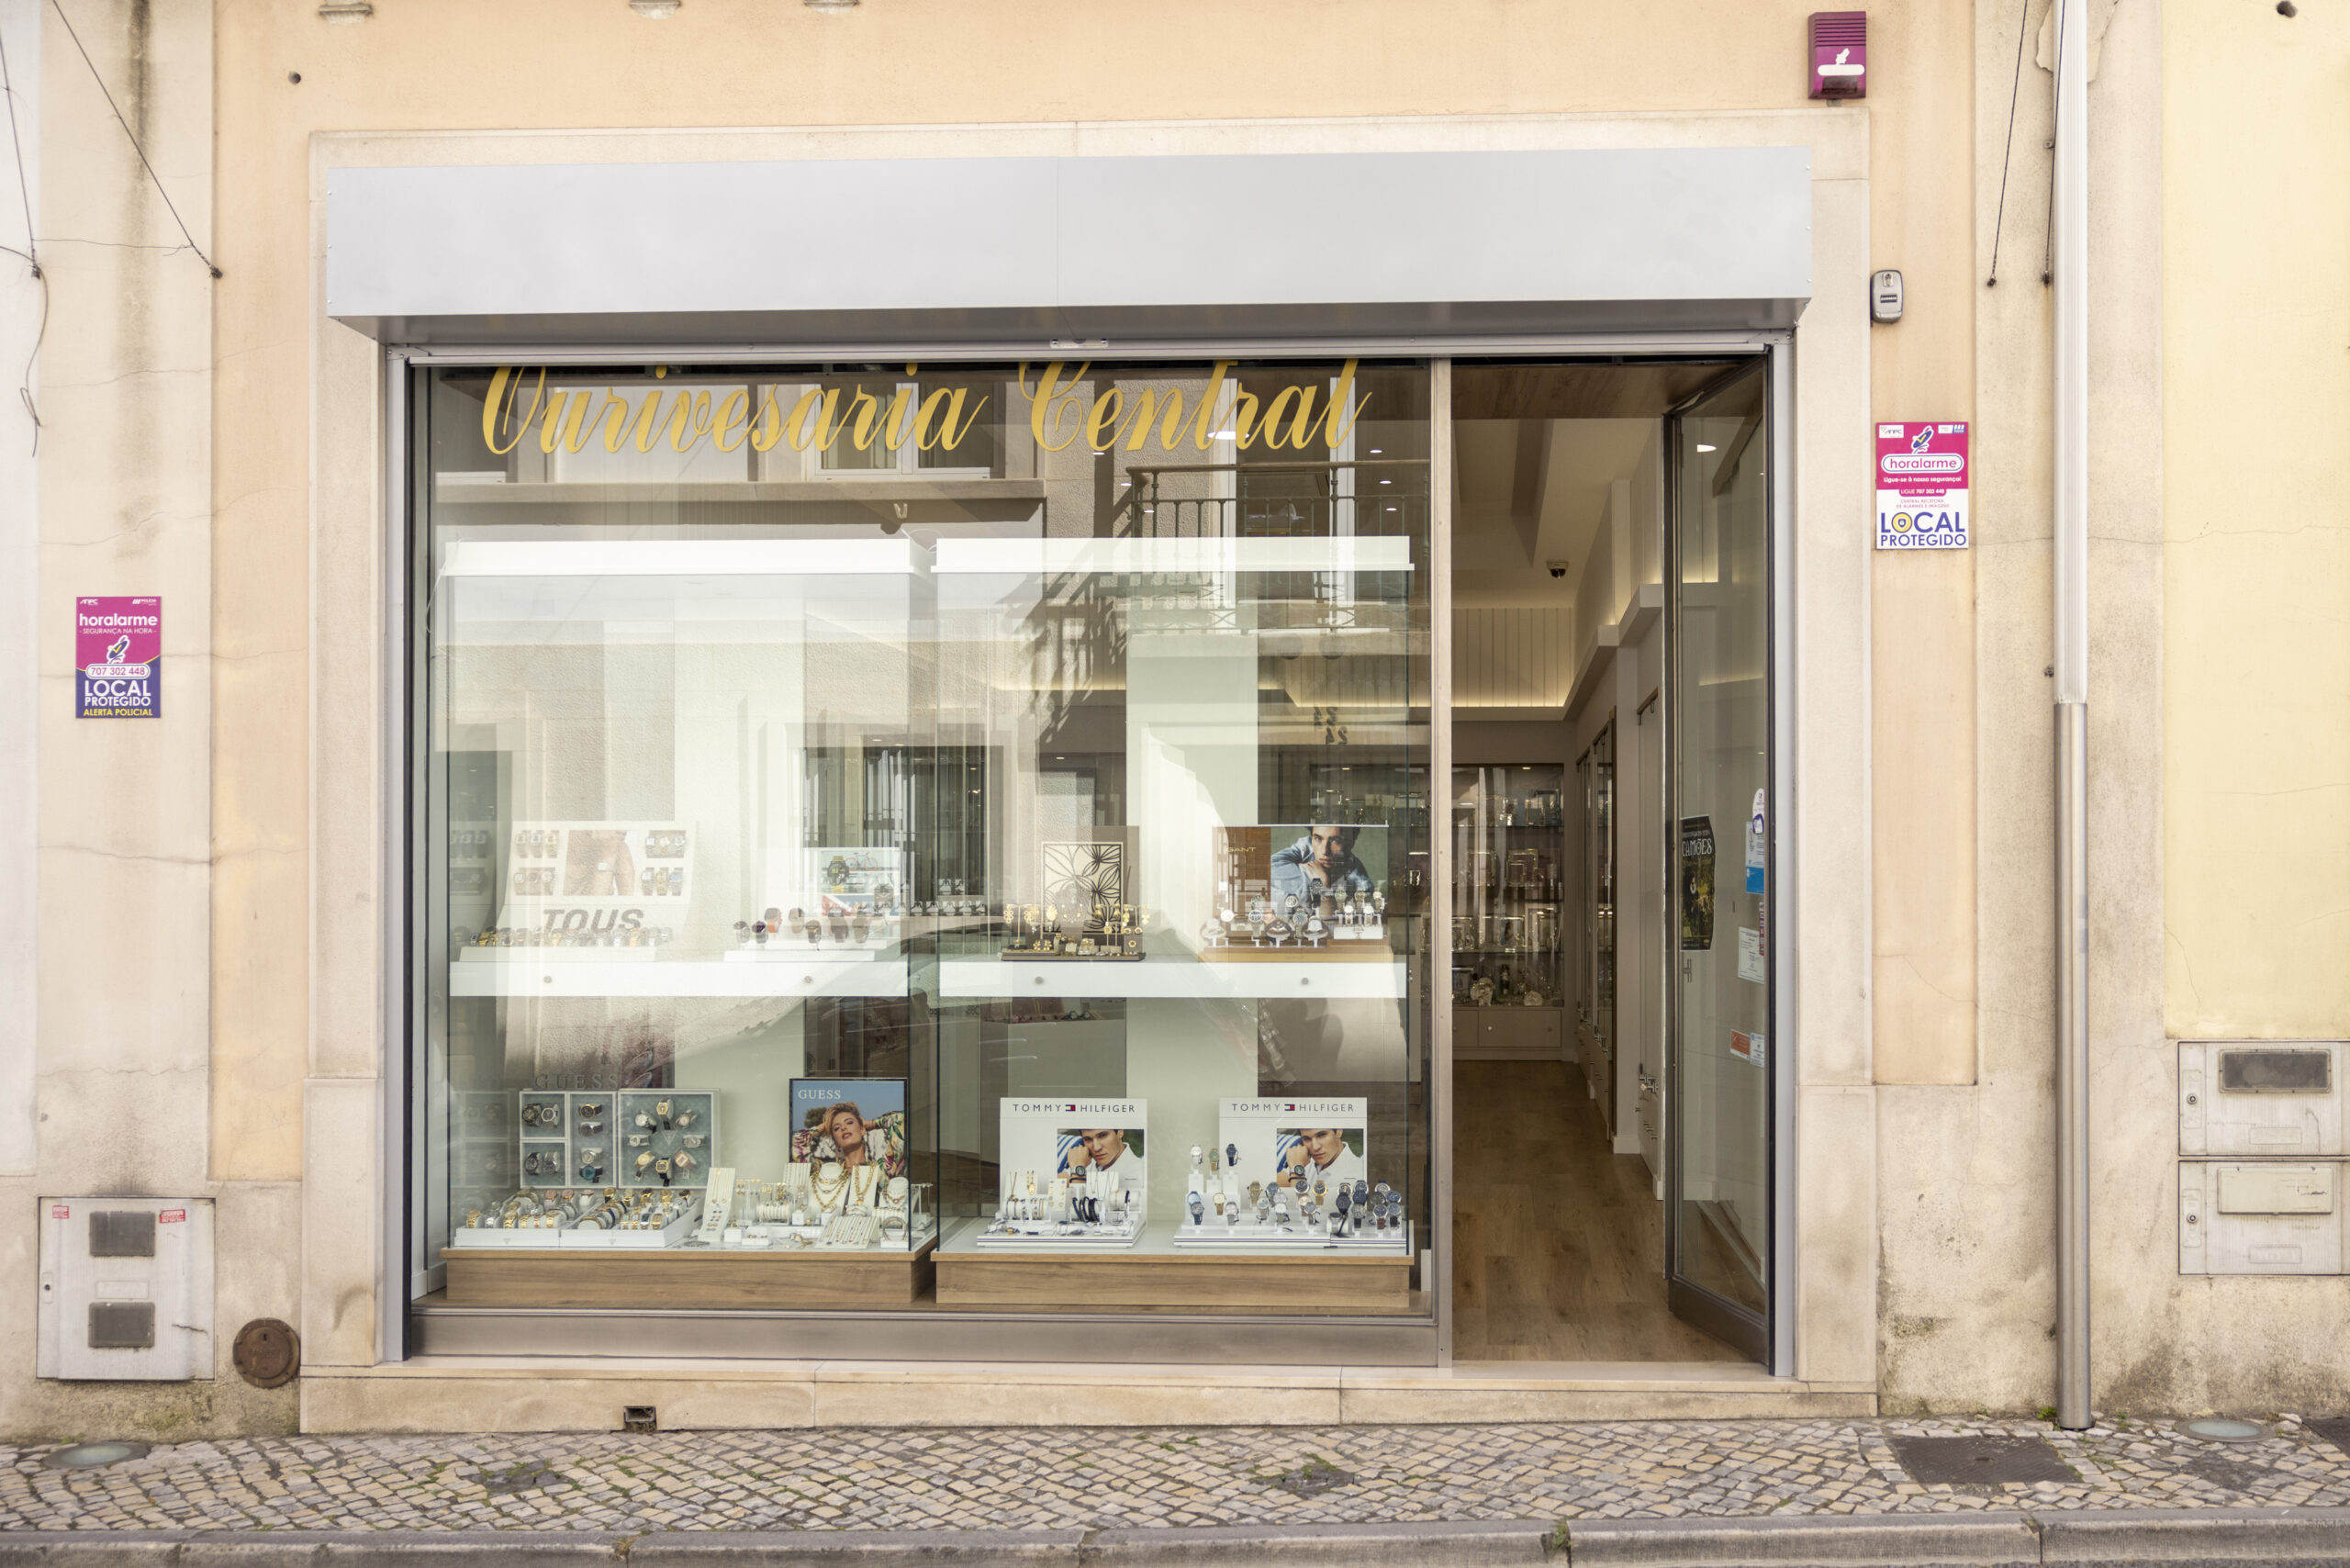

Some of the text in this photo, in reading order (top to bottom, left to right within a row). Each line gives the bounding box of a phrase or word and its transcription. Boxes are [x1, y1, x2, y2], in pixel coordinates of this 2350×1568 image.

[483, 358, 1372, 454] Ourivesaria Central
[1890, 458, 1957, 469] horalarme
[1881, 511, 1965, 533] LOCAL
[1881, 533, 1966, 546] PROTEGIDO
[79, 612, 158, 626] horalarme
[91, 667, 146, 676] 707 302 448
[84, 679, 151, 697] LOCAL
[84, 696, 151, 707] PROTEGIDO
[84, 708, 153, 716] ALERTA POLICIAL
[1682, 838, 1712, 857] CAMÕES
[543, 908, 644, 931] TOUS
[535, 1072, 620, 1091] GUESS
[798, 1089, 841, 1100] GUESS
[1013, 1103, 1136, 1113] TOMMY HILFIGER
[1232, 1103, 1354, 1113] TOMMY HILFIGER
